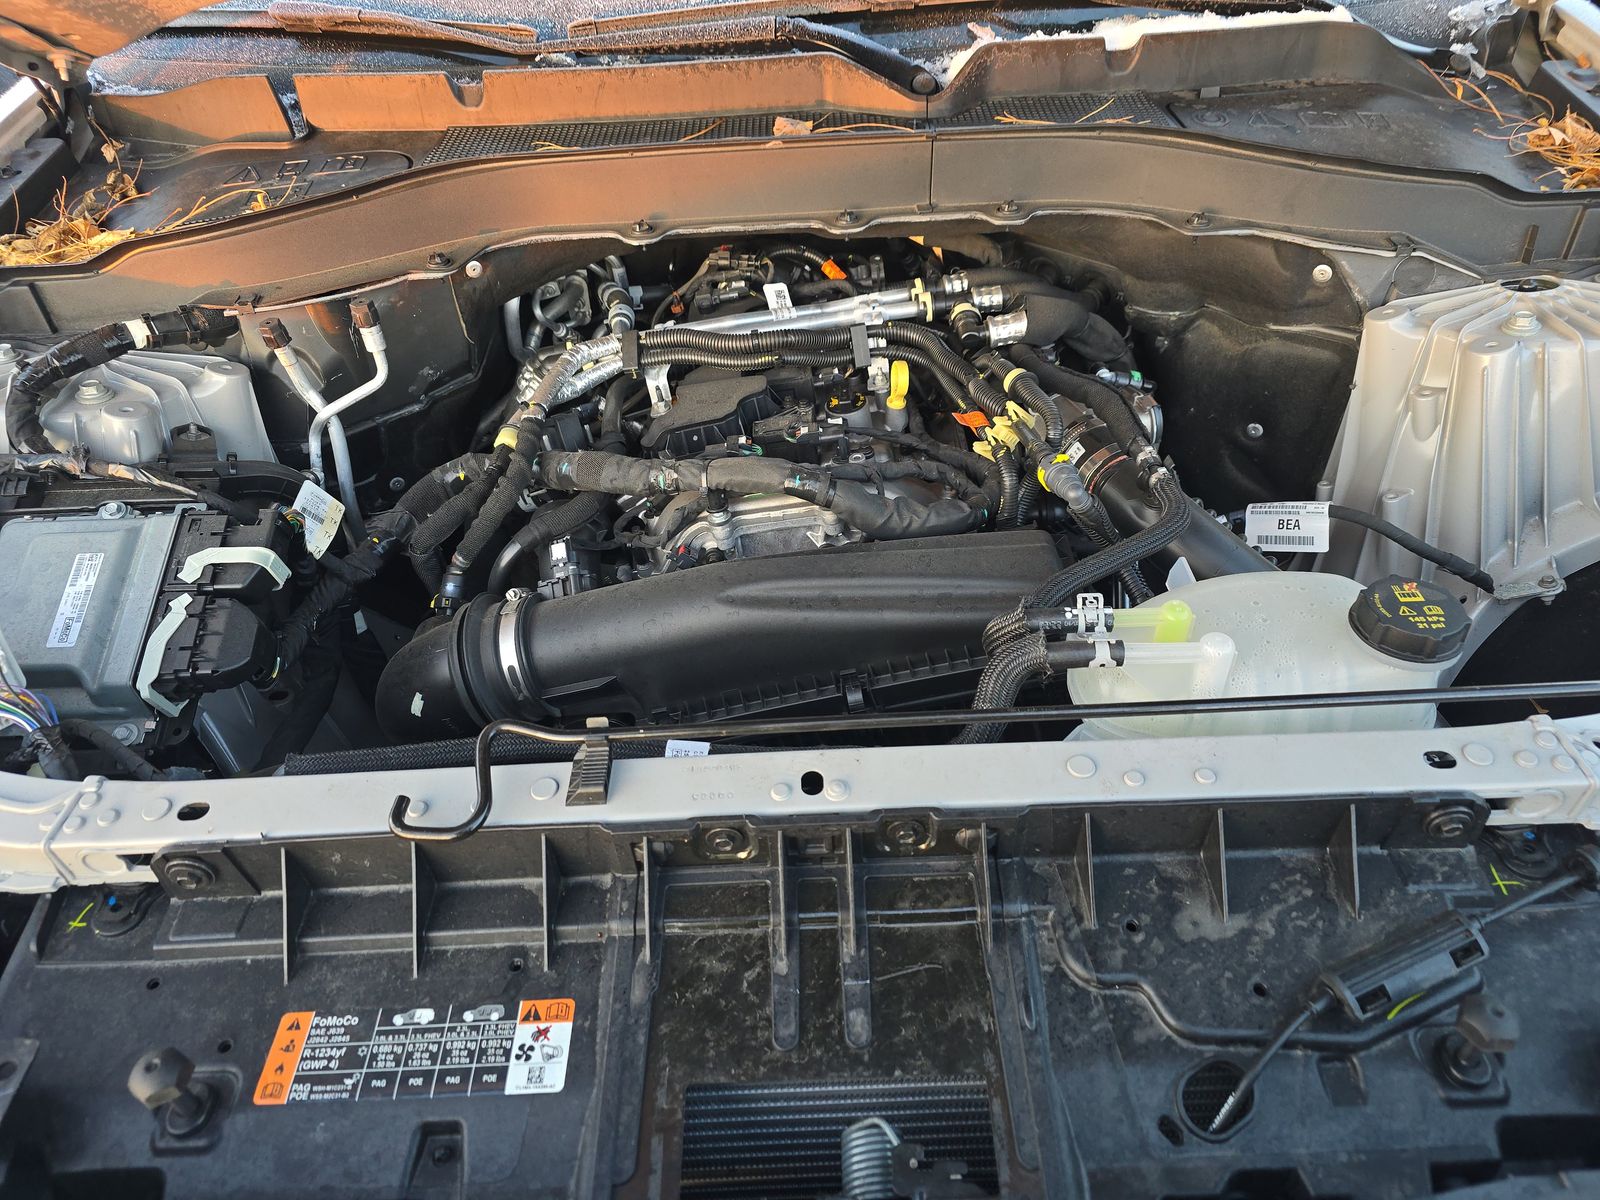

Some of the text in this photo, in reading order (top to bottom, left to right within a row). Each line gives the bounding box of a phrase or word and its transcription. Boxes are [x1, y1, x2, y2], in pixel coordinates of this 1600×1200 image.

[1277, 518, 1301, 530] BEA
[323, 531, 333, 540] TK
[313, 545, 324, 556] TK
[58, 617, 74, 642] FoMoCo
[312, 1014, 359, 1027] FoMoCo
[393, 1044, 403, 1054] kg
[407, 1043, 439, 1053] 0.737 kg
[466, 1040, 477, 1051] kg
[502, 1039, 512, 1049] kg
[303, 1047, 347, 1059] R-1234yf
[299, 1059, 340, 1071] (GWP 4)
[371, 1079, 387, 1088] PAG
[408, 1077, 424, 1086] POE
[445, 1076, 461, 1085] PAG
[482, 1074, 498, 1083] POE
[292, 1083, 311, 1092] PAG
[289, 1092, 309, 1101] POE
